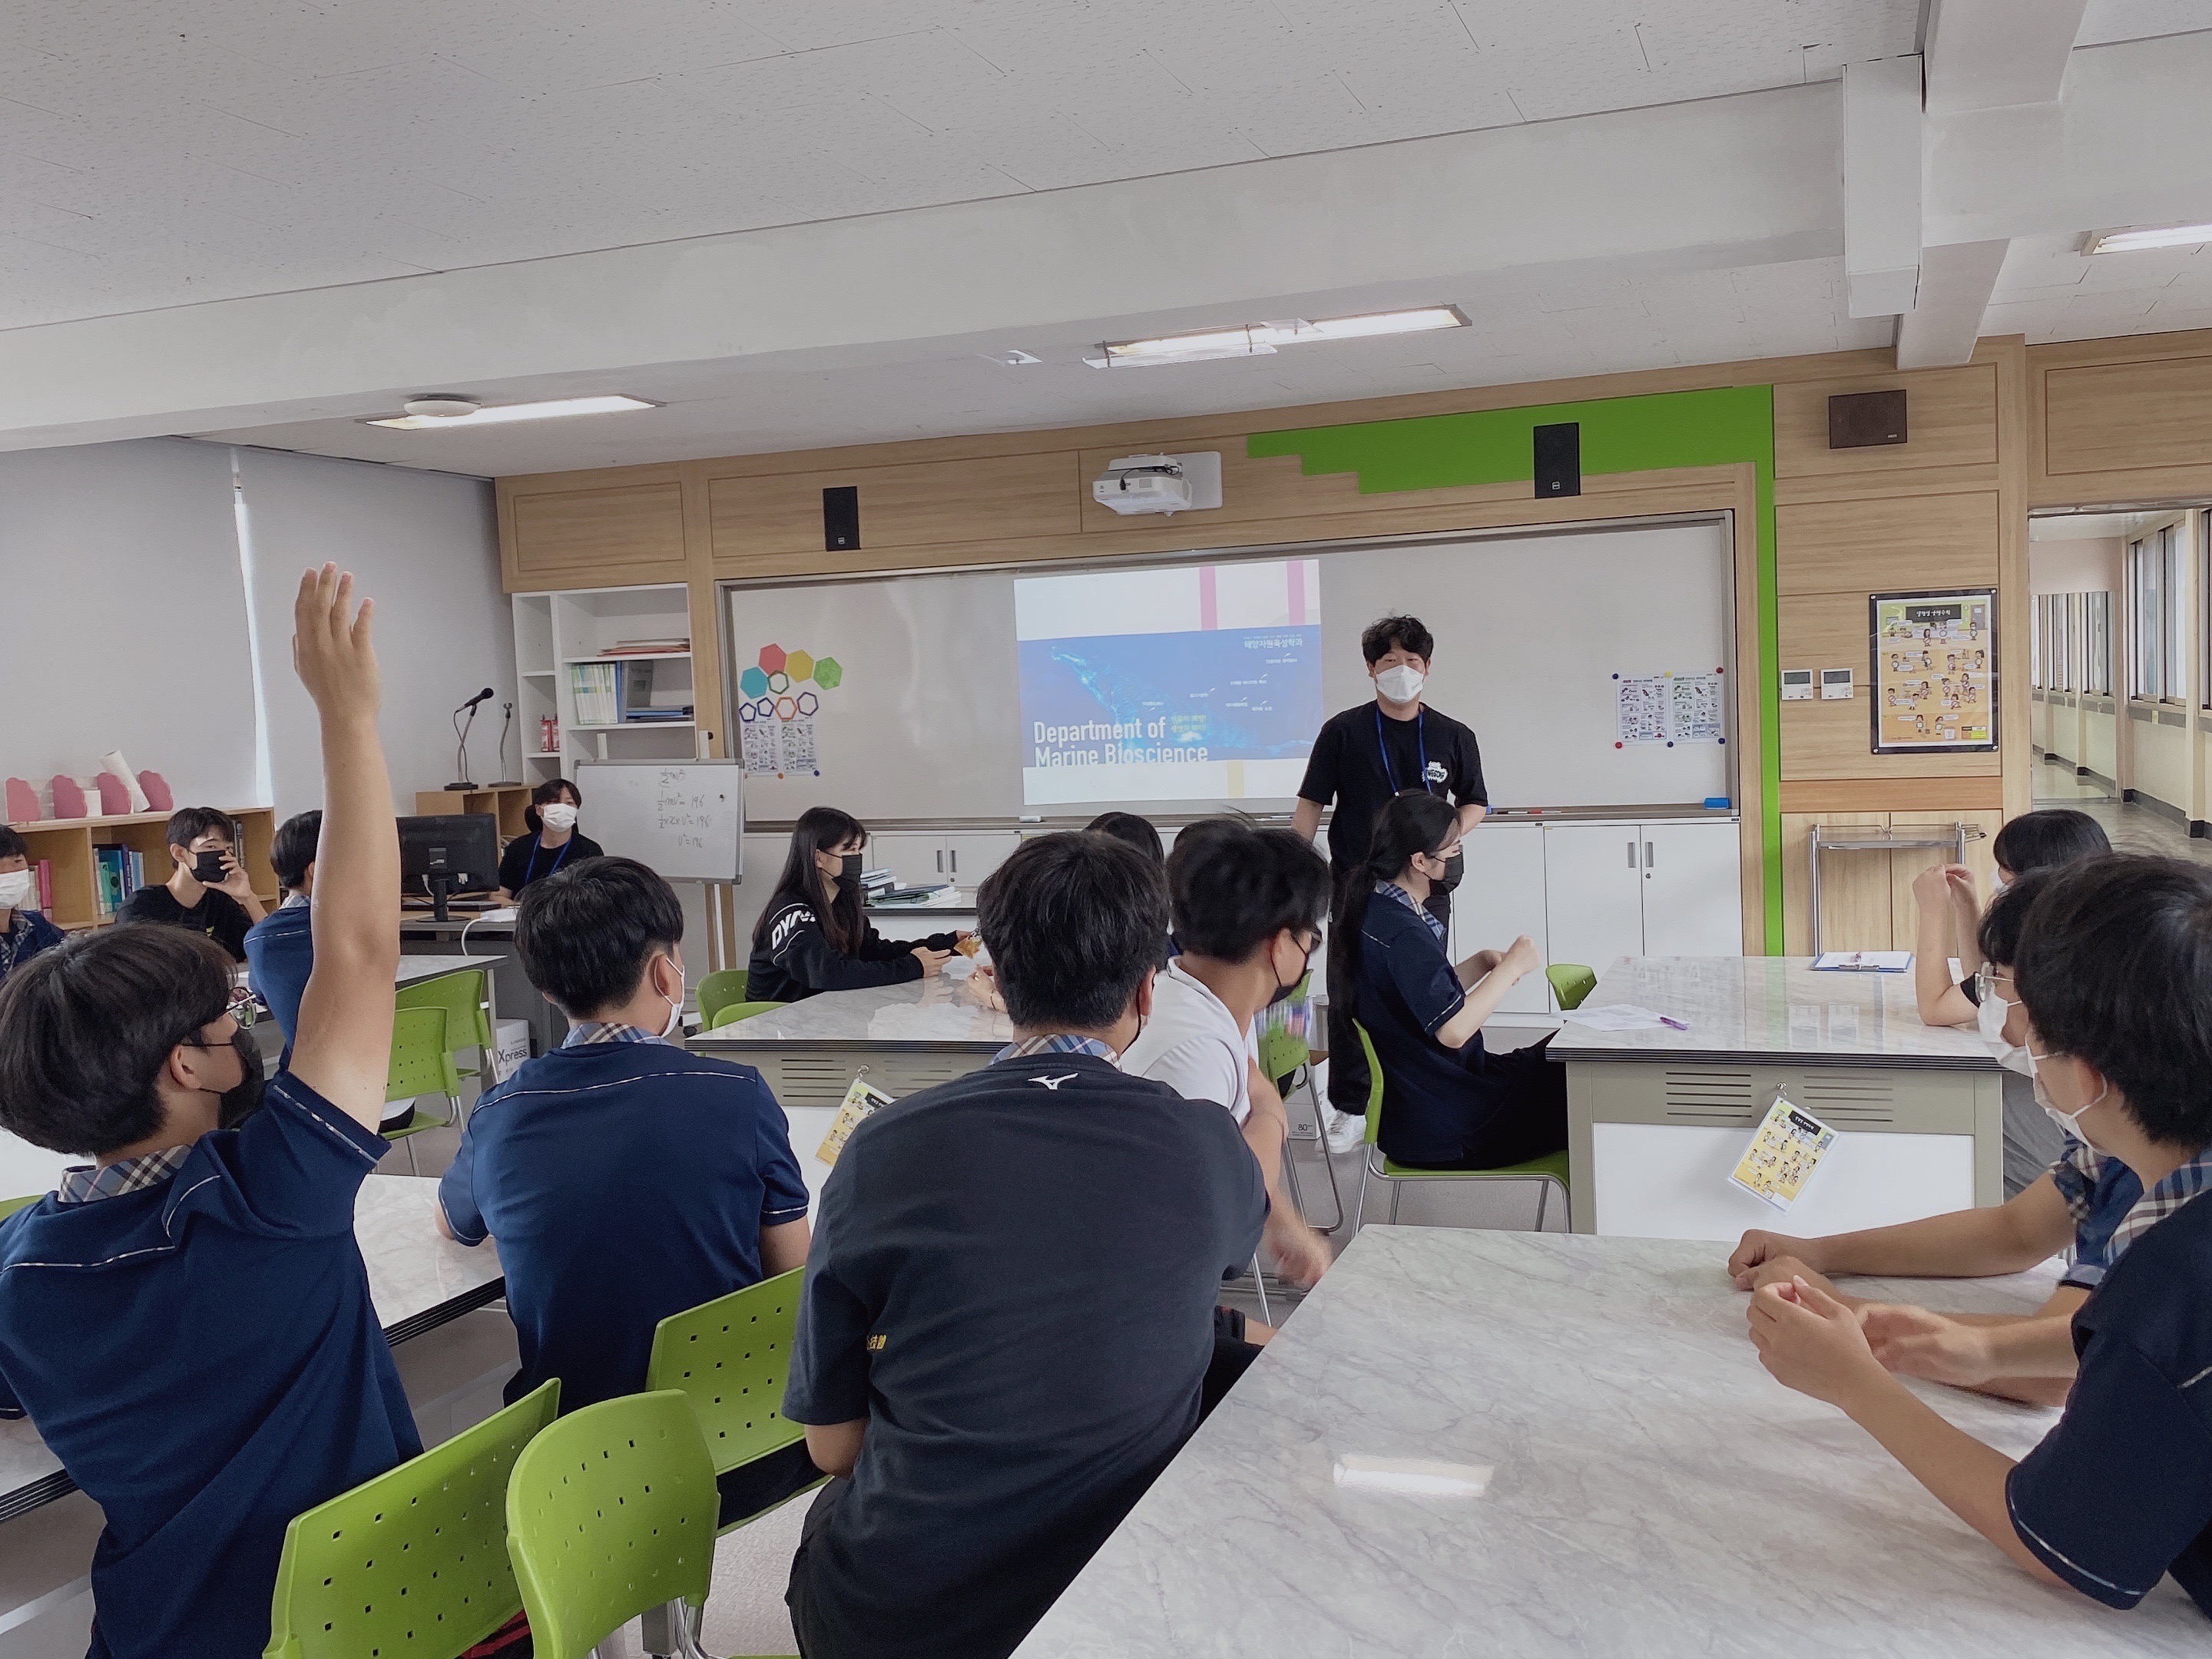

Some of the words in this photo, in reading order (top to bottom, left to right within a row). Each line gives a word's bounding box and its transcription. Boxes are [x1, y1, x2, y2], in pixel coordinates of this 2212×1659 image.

[1033, 718, 1142, 749] Department
[1147, 716, 1166, 739] of
[1035, 745, 1099, 768] Marine
[1104, 742, 1208, 765] Bioscience
[498, 1048, 528, 1066] Xpress
